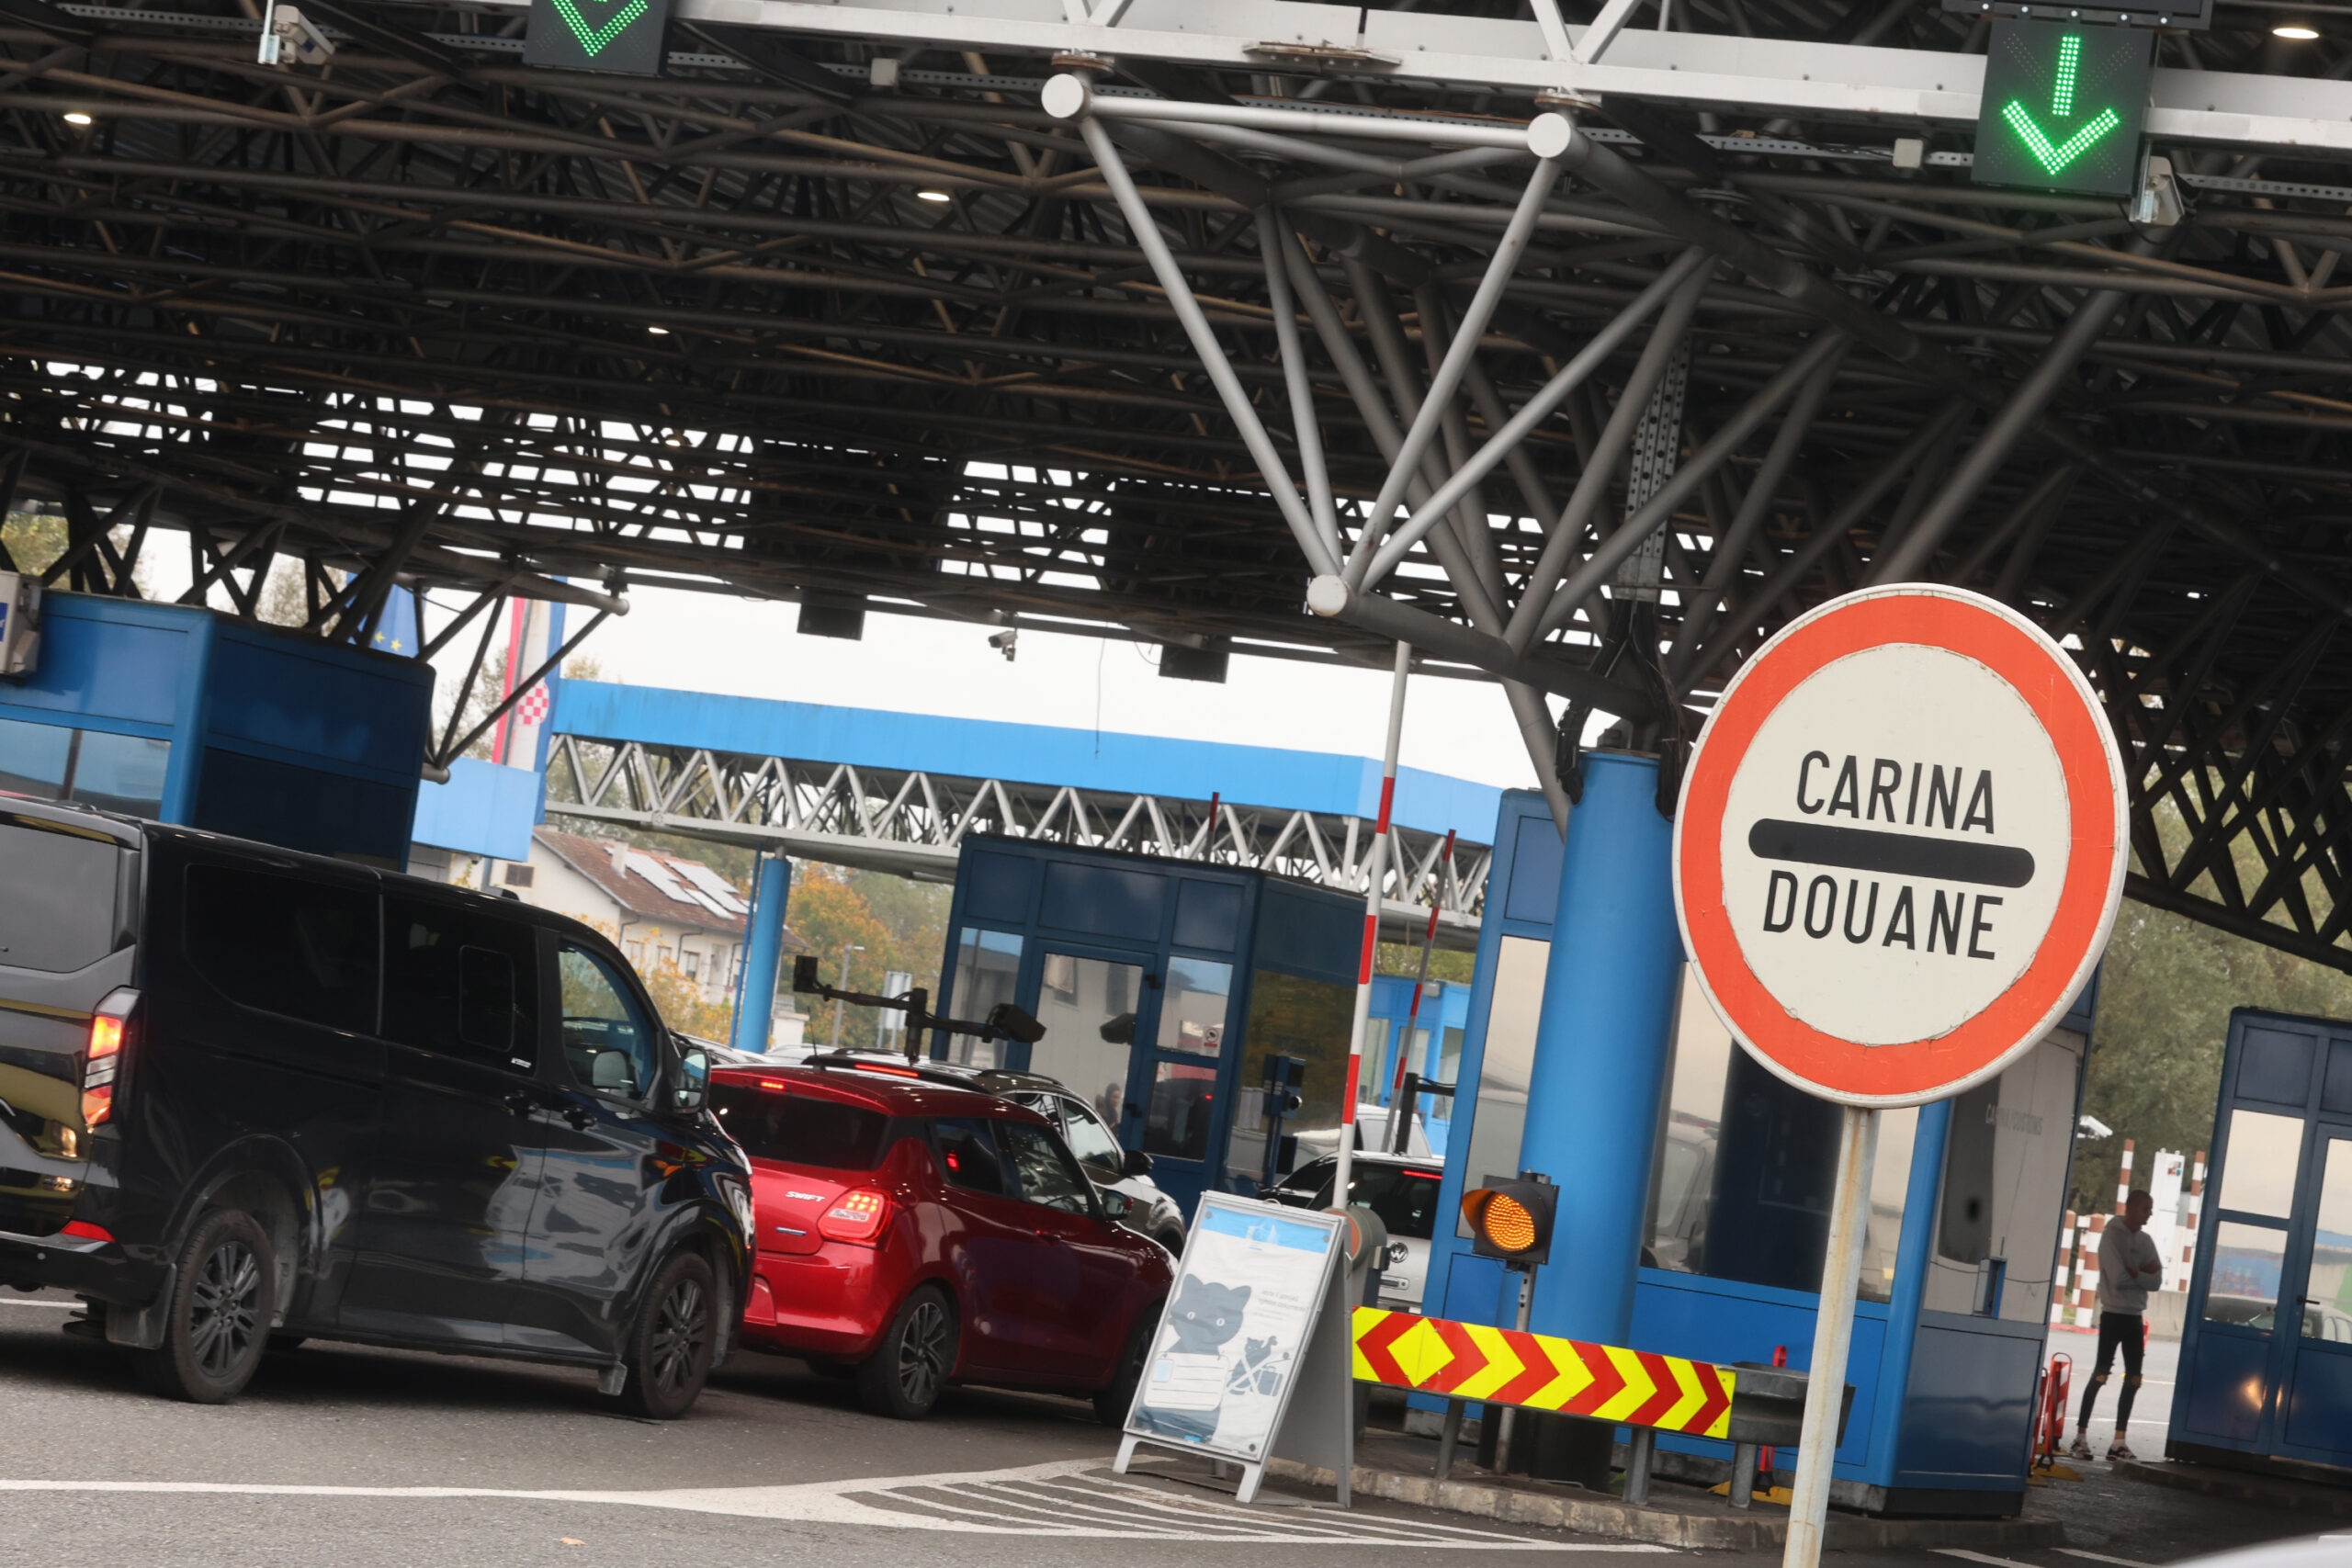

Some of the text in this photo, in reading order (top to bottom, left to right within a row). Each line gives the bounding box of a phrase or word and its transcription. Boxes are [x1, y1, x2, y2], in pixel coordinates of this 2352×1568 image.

[1796, 750, 1995, 834] CARINA
[1762, 869, 2004, 961] DOUANE
[786, 1190, 826, 1202] SWIFT
